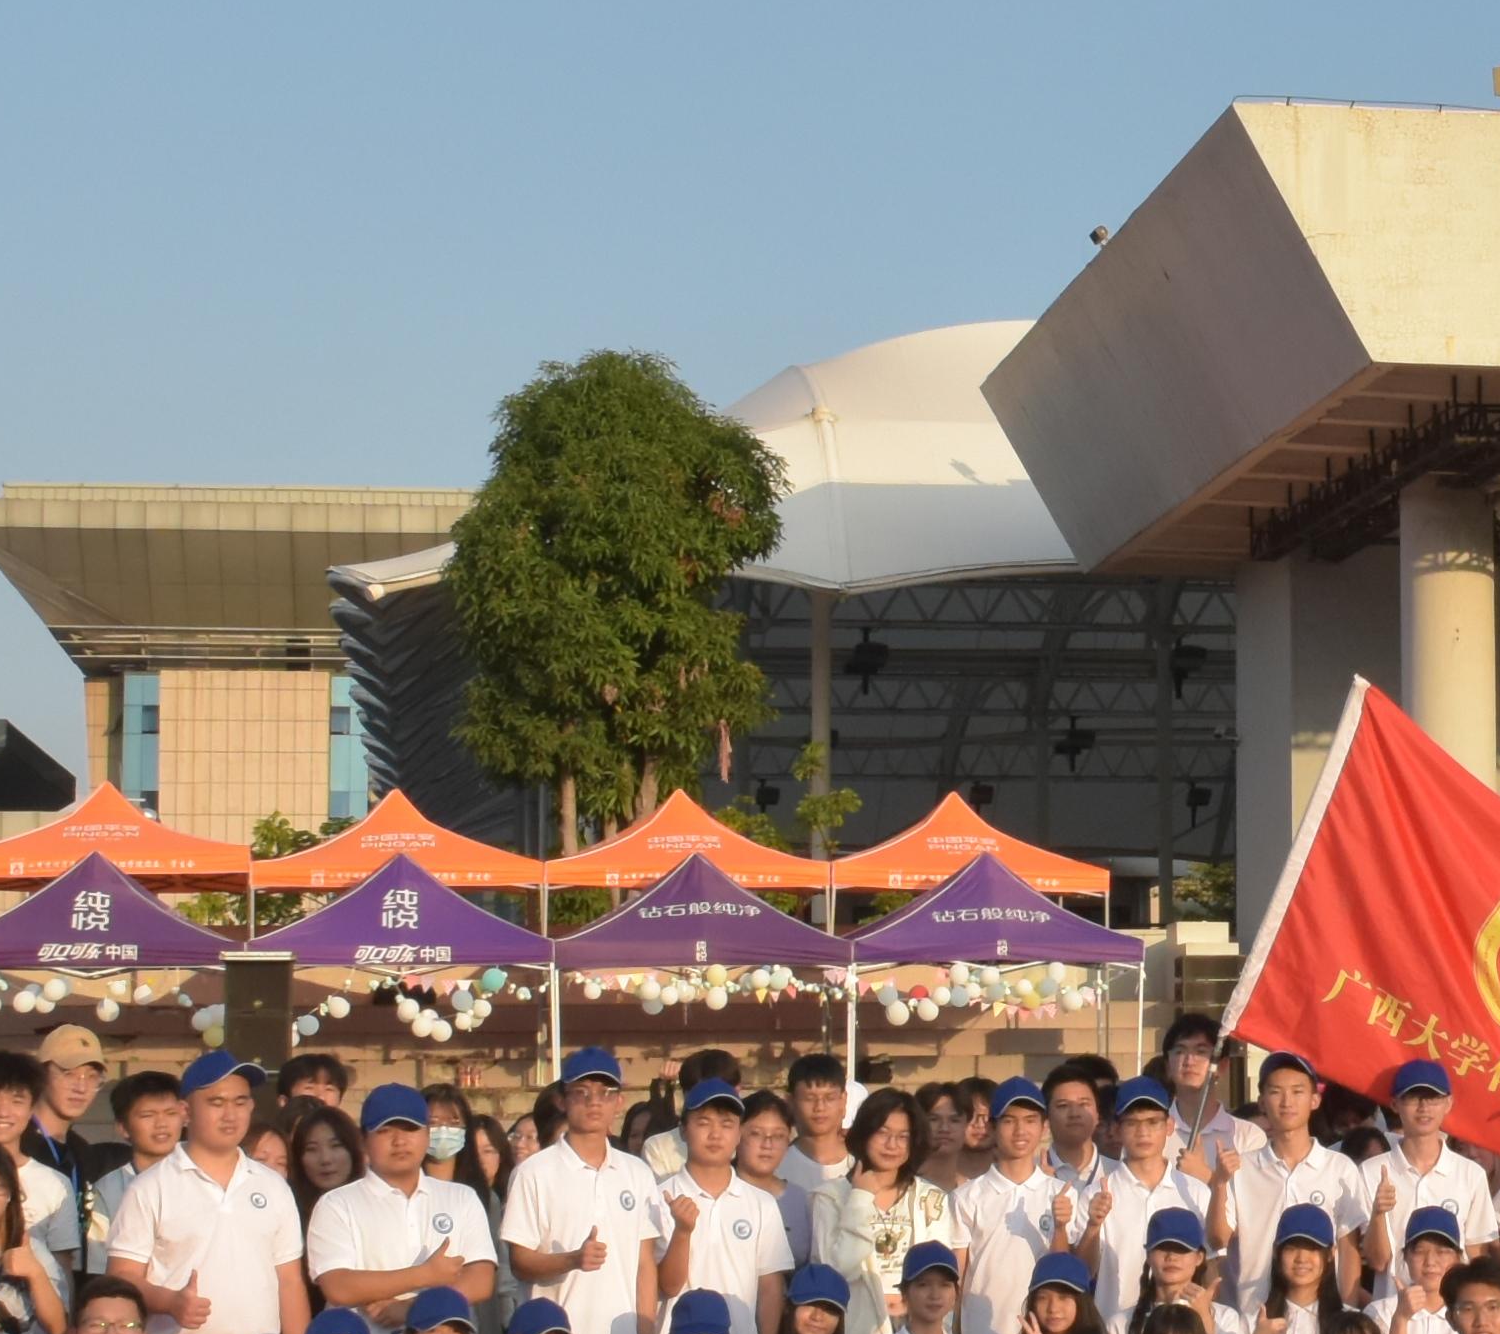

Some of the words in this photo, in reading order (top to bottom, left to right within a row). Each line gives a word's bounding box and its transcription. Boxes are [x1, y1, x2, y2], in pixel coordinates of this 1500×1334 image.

[71, 890, 111, 931] 纯悦
[381, 888, 419, 929] 纯悦
[639, 902, 761, 919] 钻石般纯净
[932, 907, 1051, 923] 钻石般纯净
